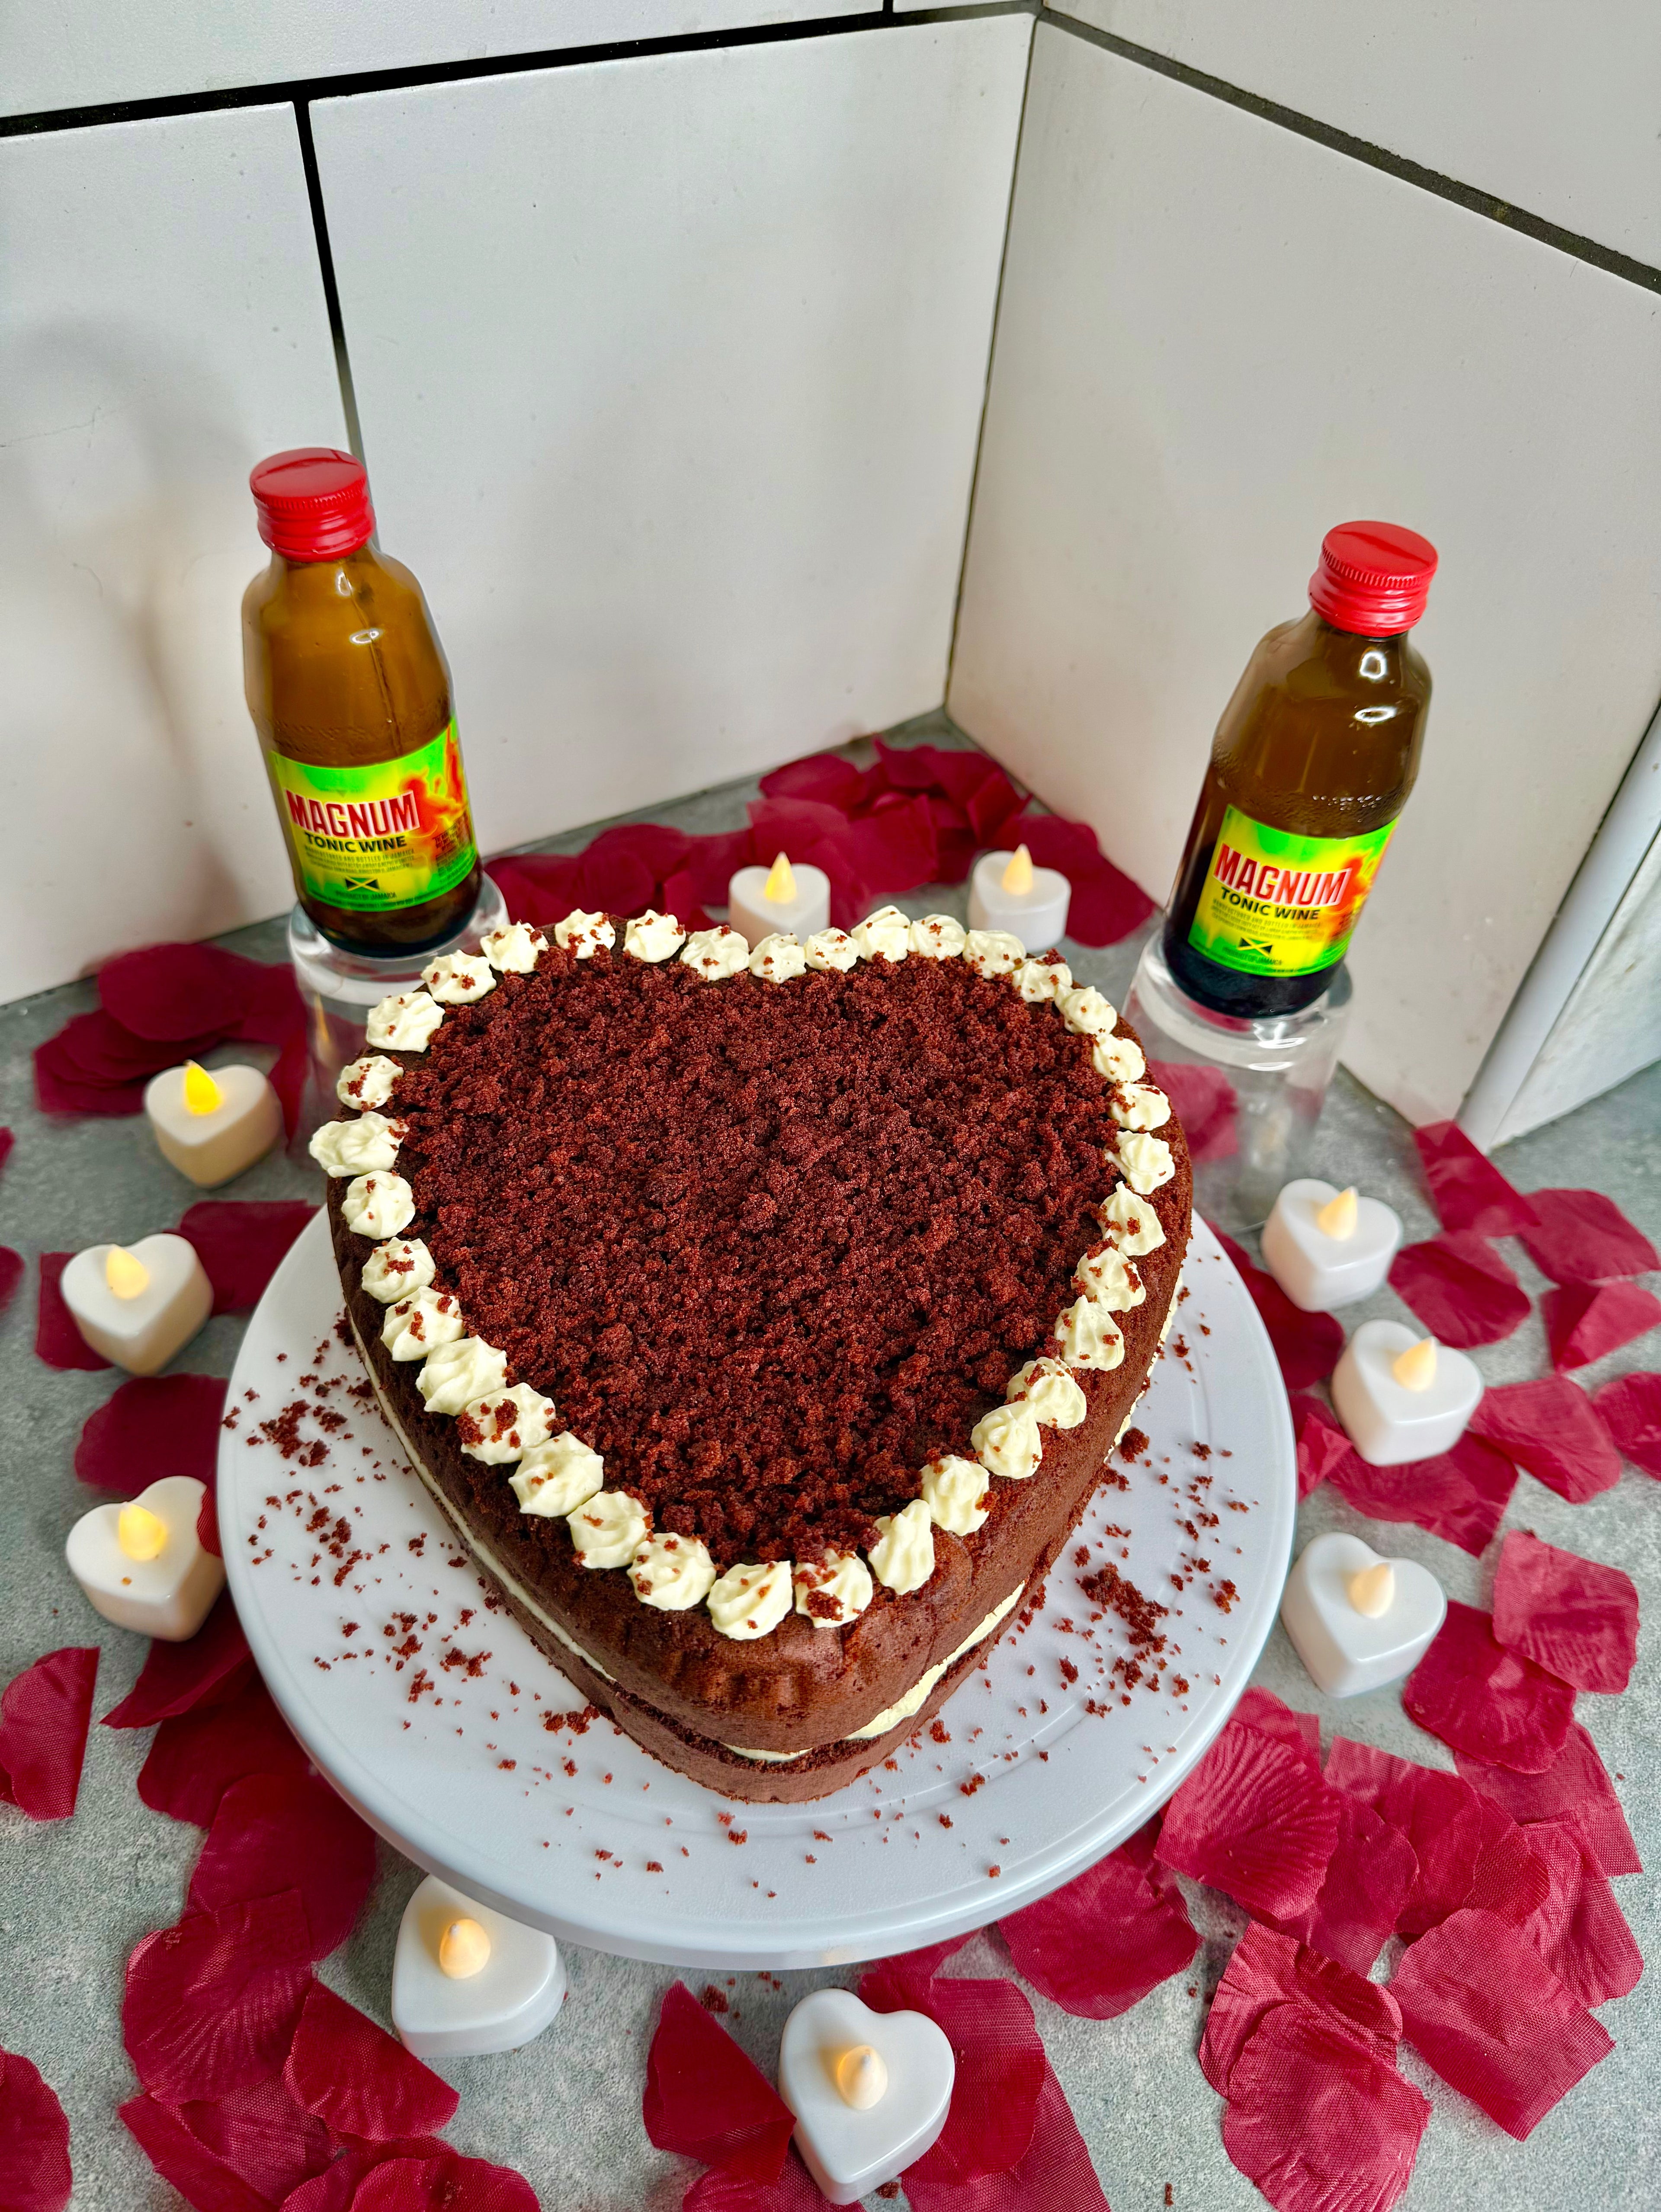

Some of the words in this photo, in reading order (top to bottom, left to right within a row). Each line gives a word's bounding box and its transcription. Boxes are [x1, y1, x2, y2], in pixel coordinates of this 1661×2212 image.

[285, 789, 419, 839] MAGNUM
[305, 832, 356, 853] TONIC
[359, 835, 407, 853] WINE
[1214, 843, 1351, 906] MAGNUM
[1221, 886, 1271, 916] TONIC
[1274, 908, 1321, 920] WINE
[1256, 956, 1282, 966] JAMAICA
